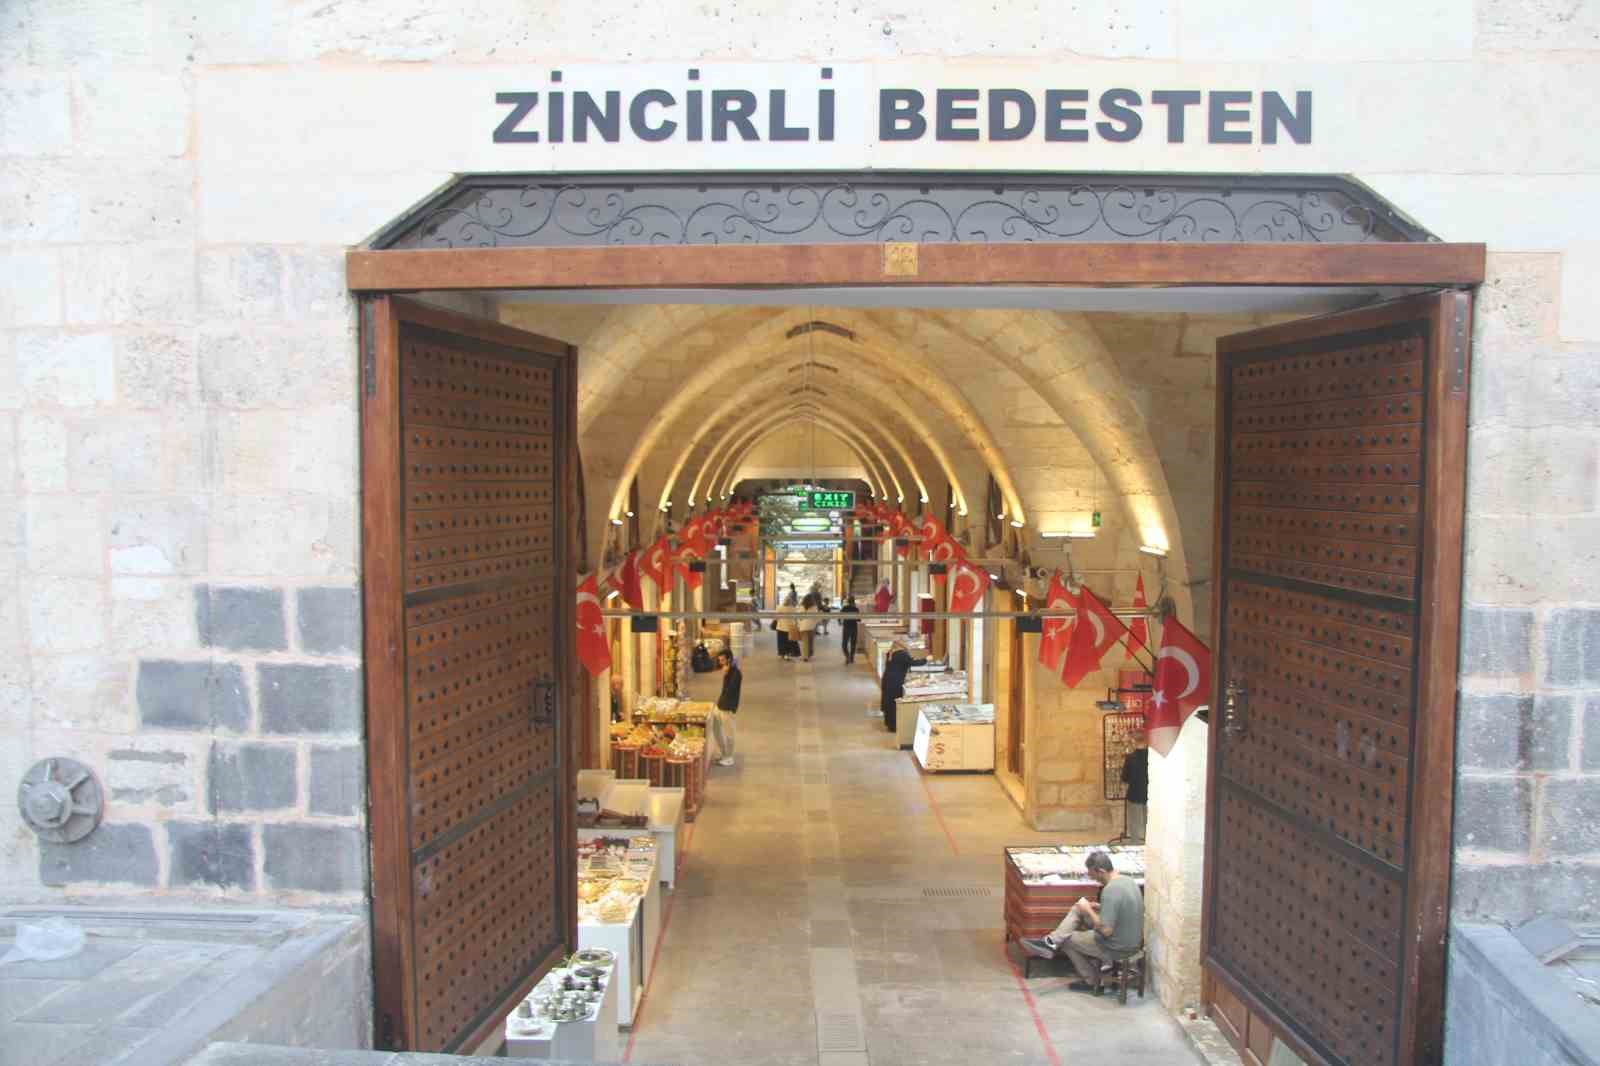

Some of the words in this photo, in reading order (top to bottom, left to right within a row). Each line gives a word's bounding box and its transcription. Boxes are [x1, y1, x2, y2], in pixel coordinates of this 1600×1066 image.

[493, 68, 835, 143] ZİNCİRLİ
[879, 89, 1312, 145] BEDESTEN
[814, 493, 849, 501] EXIT
